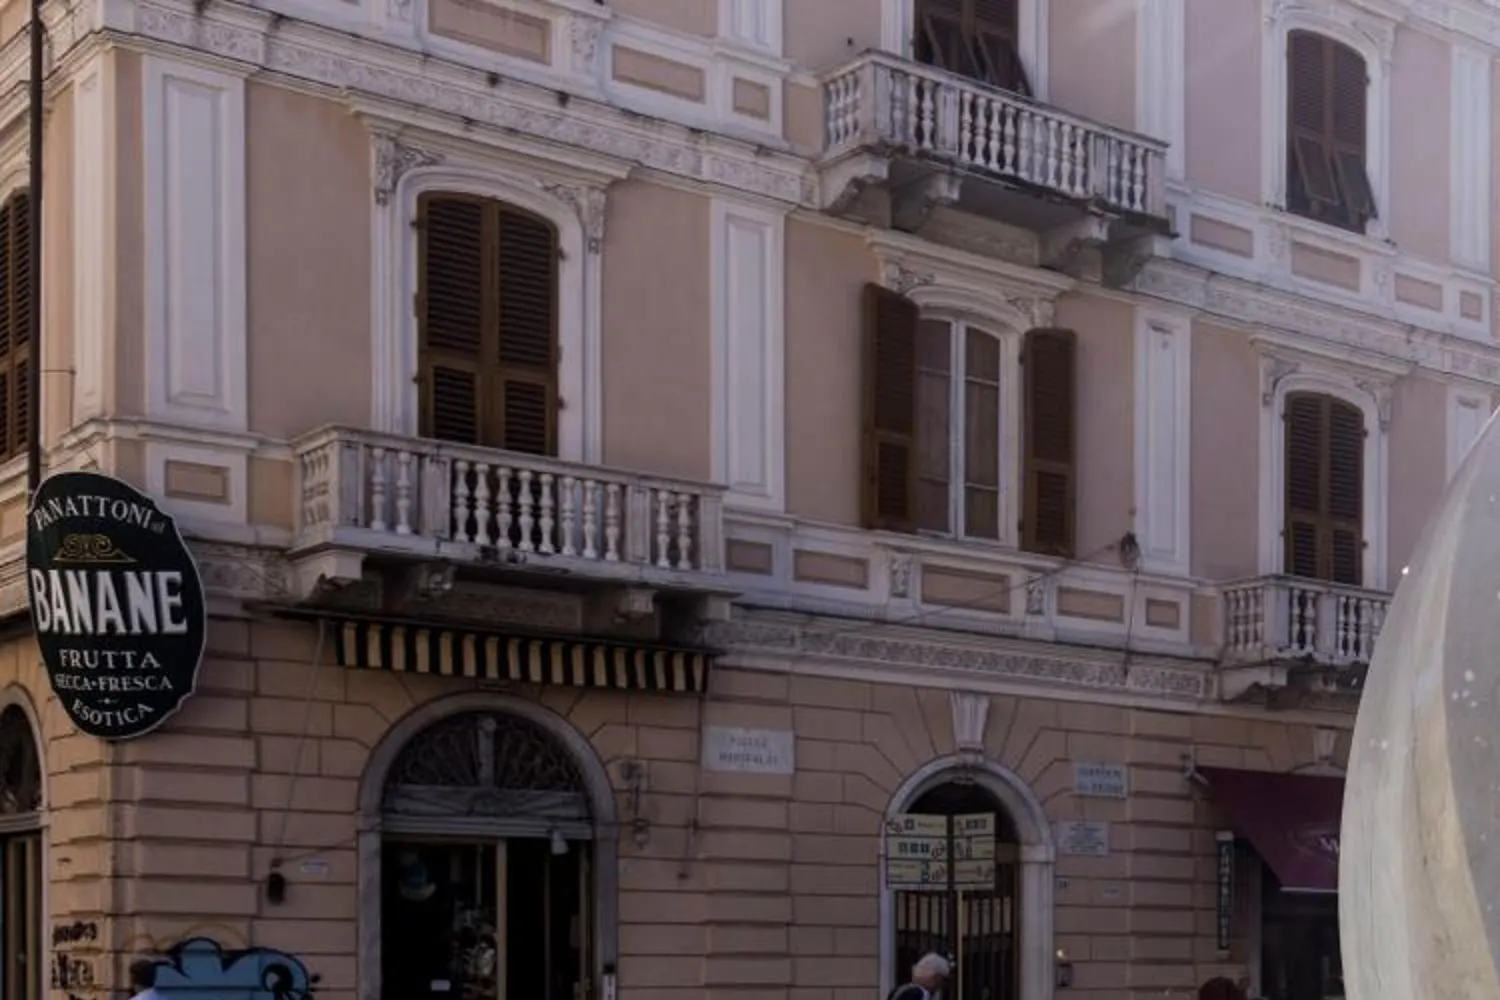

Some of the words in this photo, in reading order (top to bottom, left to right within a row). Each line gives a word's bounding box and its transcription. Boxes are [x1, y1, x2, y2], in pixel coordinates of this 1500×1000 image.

[34, 495, 153, 532] PANATTONI
[31, 568, 188, 634] BANANE
[59, 648, 161, 669] FRUTTA
[72, 698, 155, 727] ESOTICA
